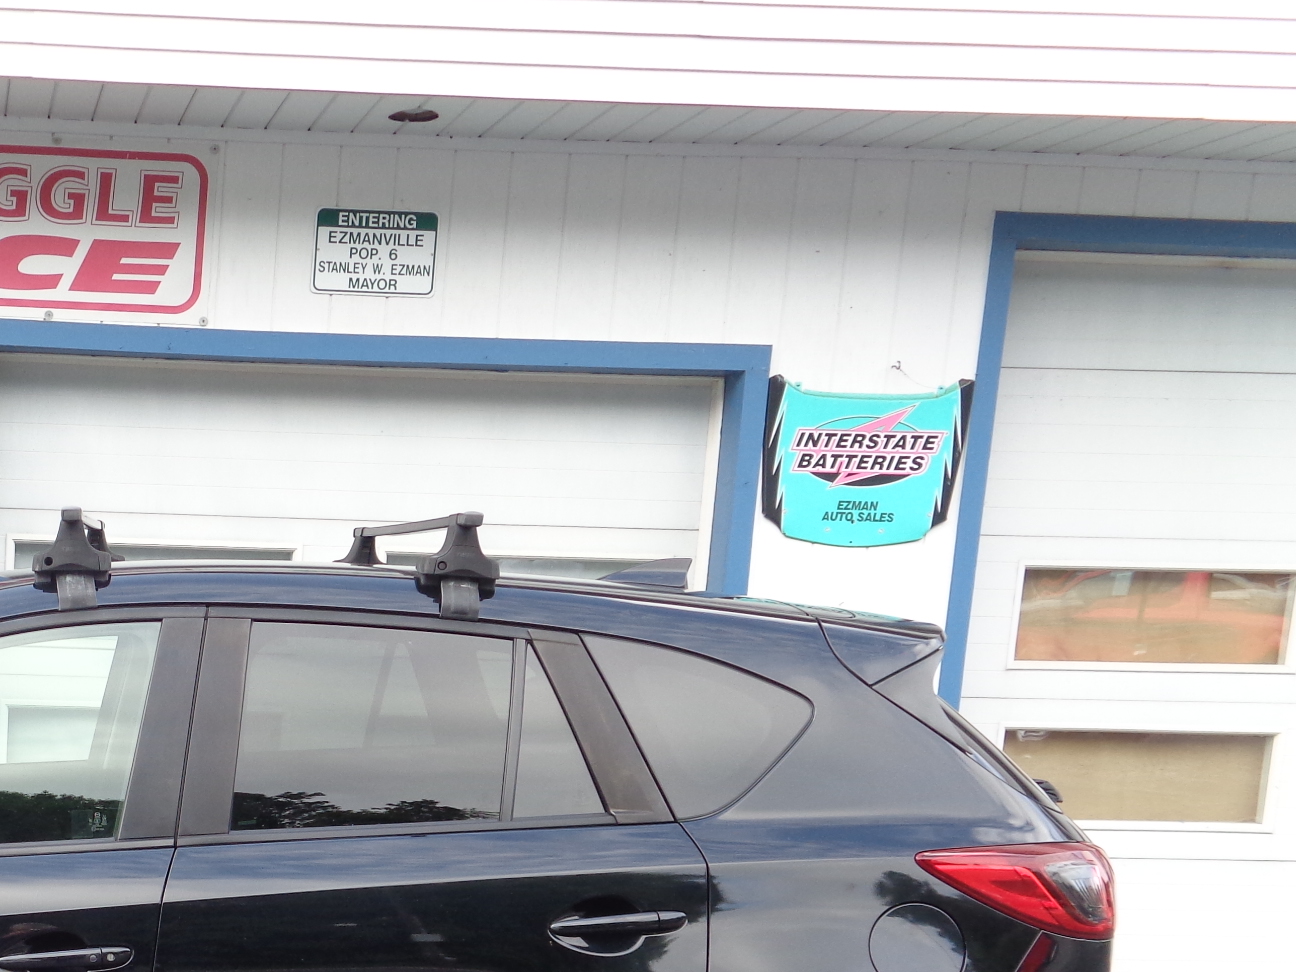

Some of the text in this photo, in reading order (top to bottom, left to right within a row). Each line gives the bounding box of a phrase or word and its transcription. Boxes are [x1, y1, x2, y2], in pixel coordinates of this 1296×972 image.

[338, 211, 417, 229] ENTERING
[328, 230, 425, 248] EZMANVILLE
[349, 247, 399, 261] POP. 6
[318, 260, 431, 277] STANLEY W. EZMAN
[348, 277, 398, 291] MAYOR
[795, 431, 940, 452] INTERSTATE
[796, 452, 927, 472] BATTERIES
[836, 500, 879, 512] EZMAN
[821, 511, 895, 523] AUTO SALES
